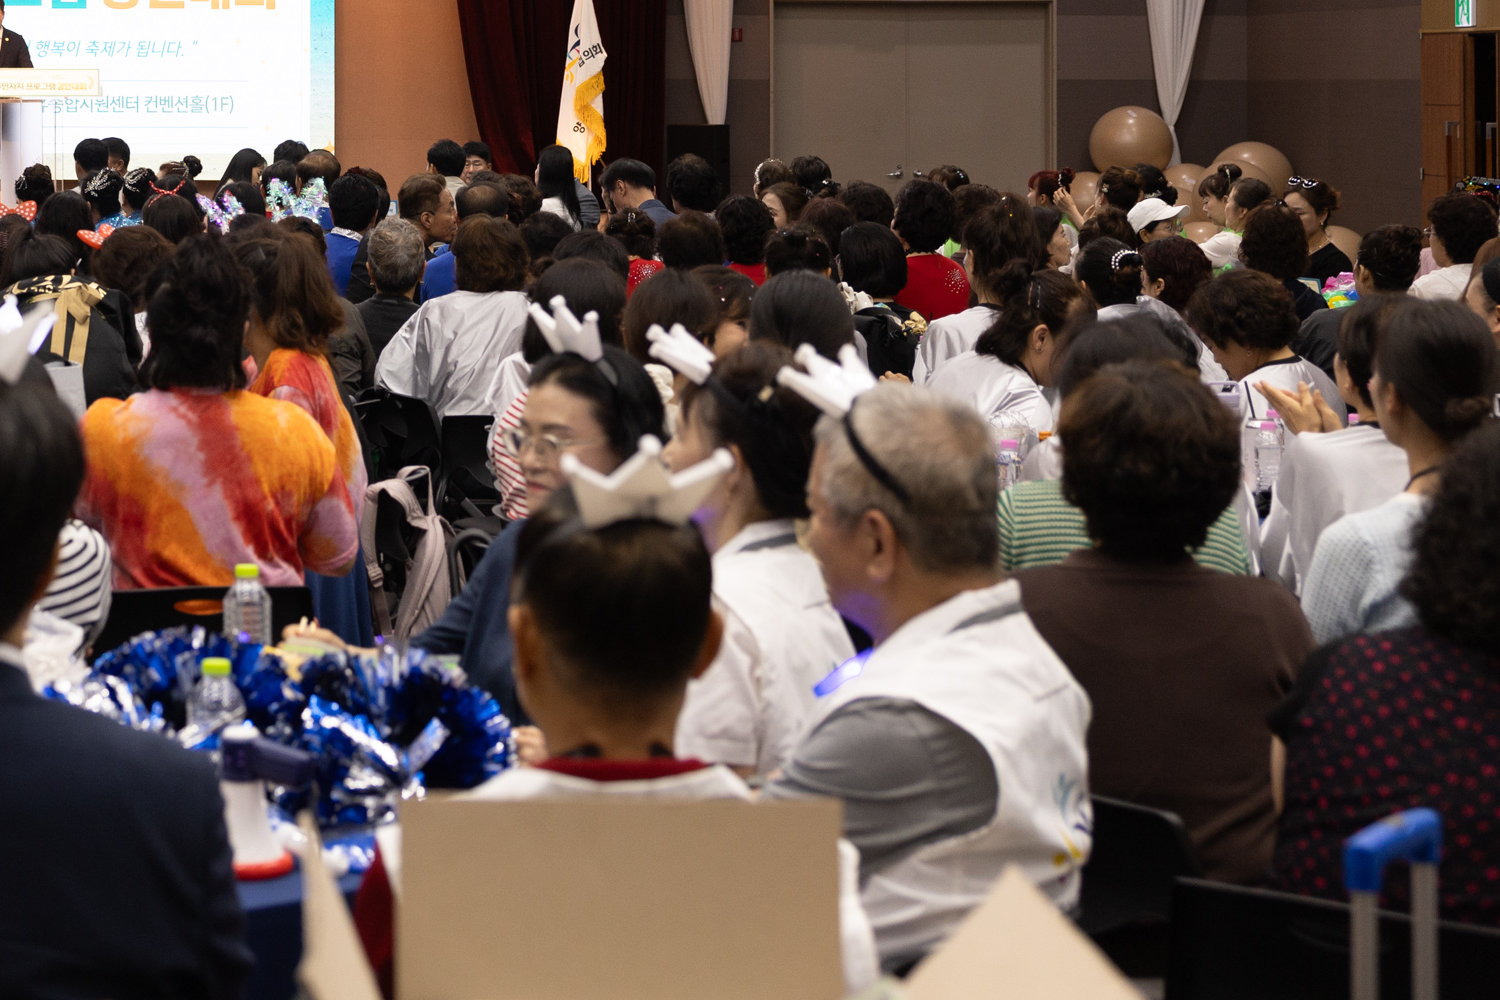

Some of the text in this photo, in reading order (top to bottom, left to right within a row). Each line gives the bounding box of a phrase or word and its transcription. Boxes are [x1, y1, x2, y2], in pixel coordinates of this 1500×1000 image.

[36, 39, 82, 58] 행복이
[85, 40, 132, 58] 축제가
[144, 94, 235, 114] 컨벤션홀(1F)
